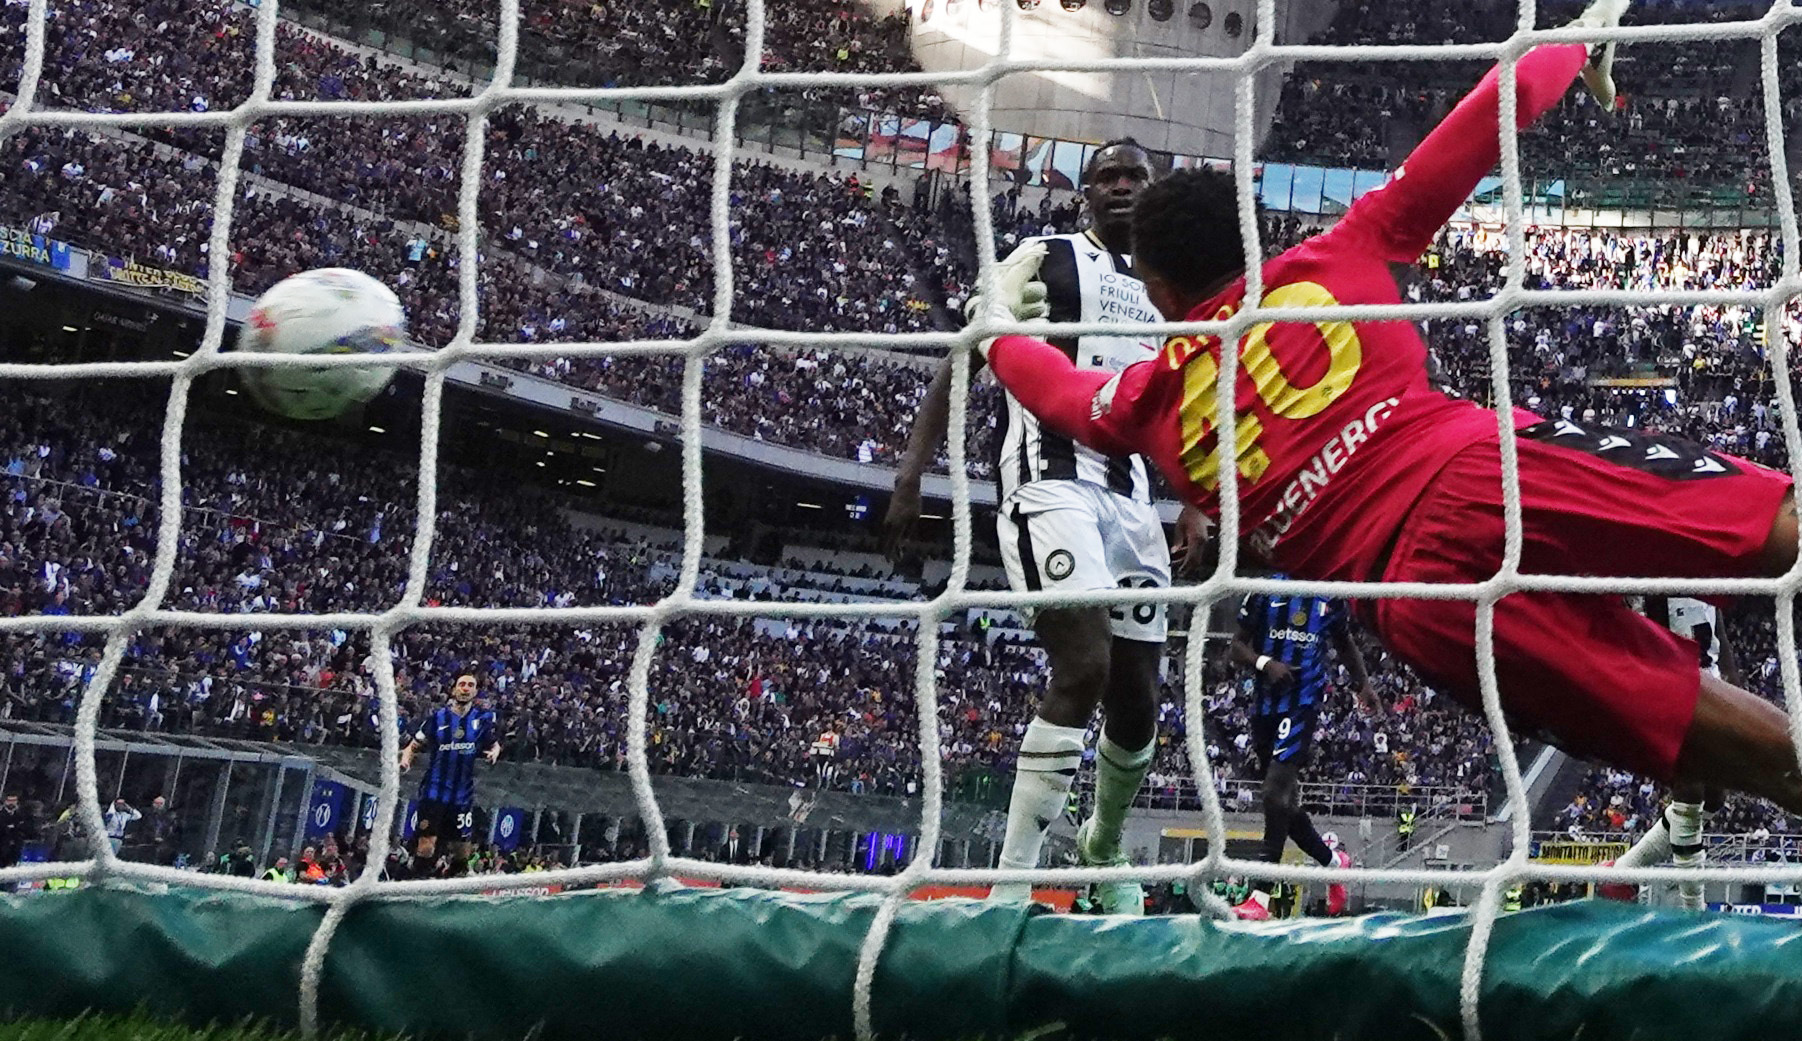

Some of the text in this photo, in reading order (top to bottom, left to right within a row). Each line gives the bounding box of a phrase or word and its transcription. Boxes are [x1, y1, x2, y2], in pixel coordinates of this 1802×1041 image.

[1100, 273, 1116, 284] IO
[1100, 285, 1140, 305] FRIULI
[1100, 300, 1157, 323] VENEZIA
[1180, 282, 1361, 492] 40
[1278, 717, 1292, 741] 9
[456, 811, 473, 830] 36
